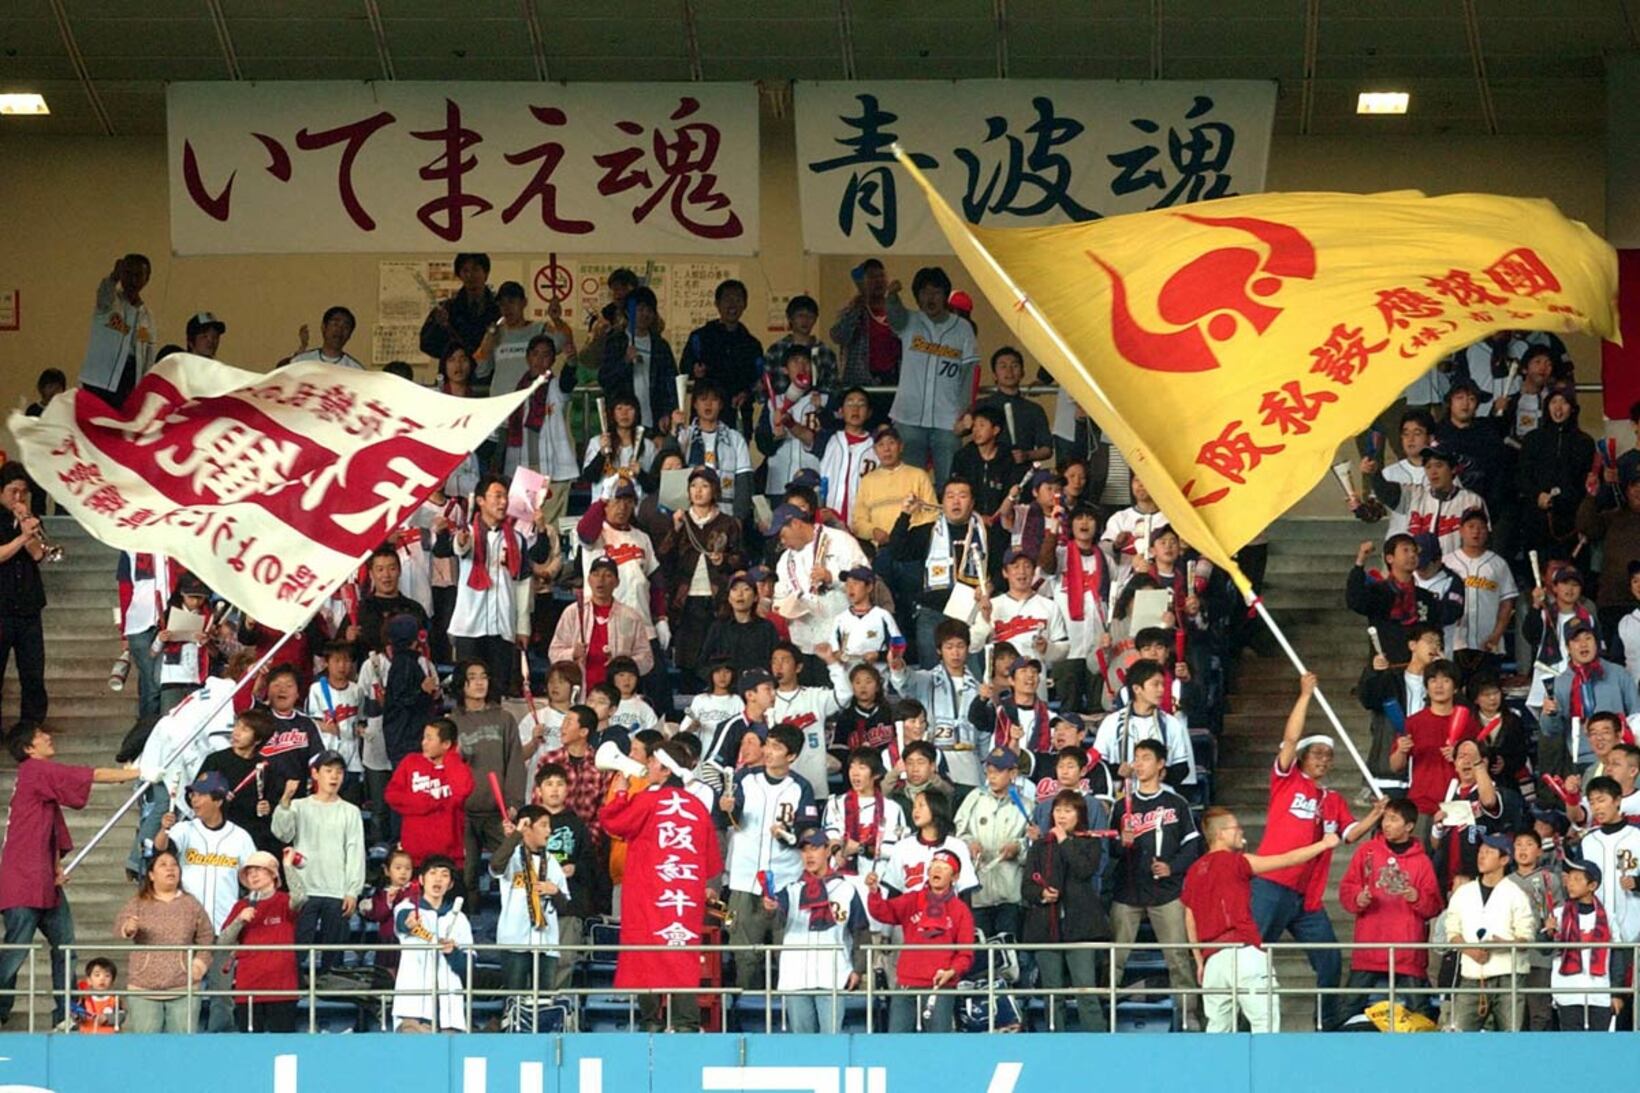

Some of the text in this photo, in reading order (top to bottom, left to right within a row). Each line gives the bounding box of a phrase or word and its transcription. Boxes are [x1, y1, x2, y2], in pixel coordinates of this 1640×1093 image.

[183, 97, 744, 242] いてまえ魂
[809, 94, 1241, 249] 青波魂
[938, 360, 959, 379] 70
[807, 733, 819, 748] 5
[935, 727, 953, 739] 23
[653, 791, 699, 946] 大阪紅牛會
